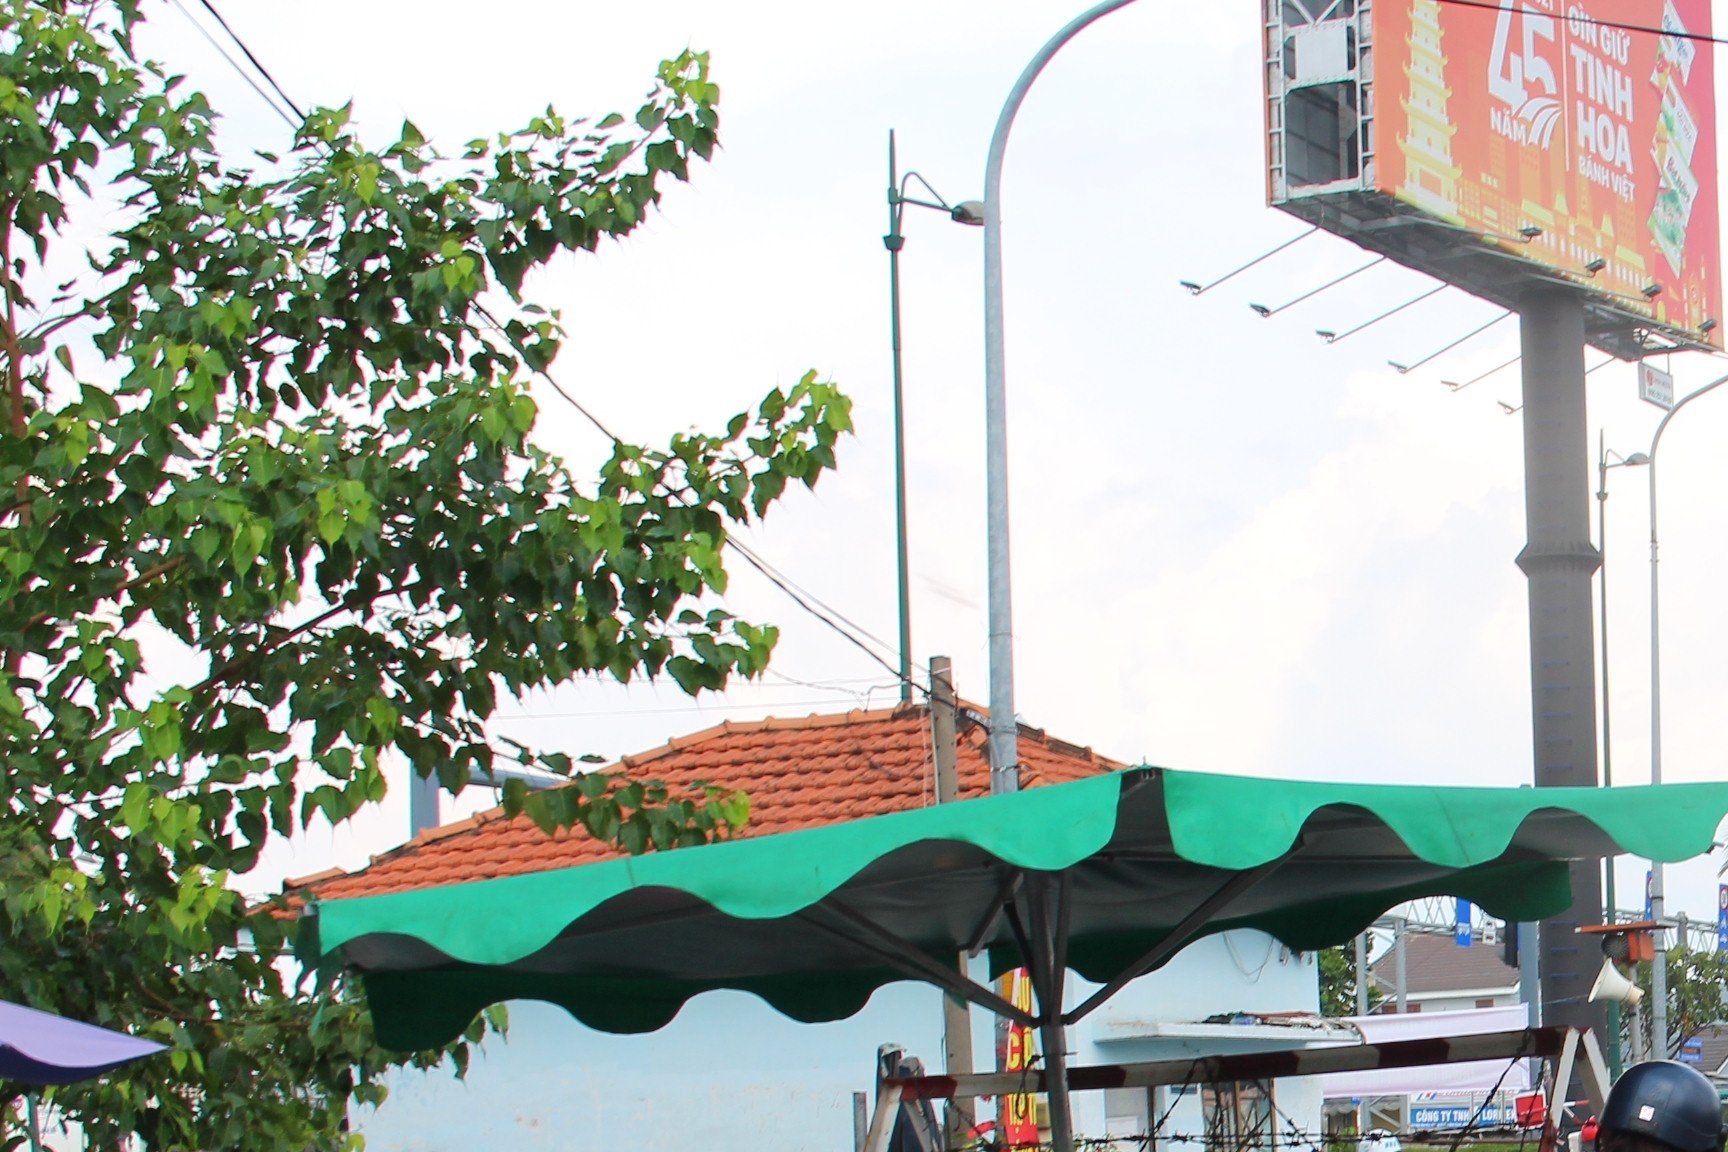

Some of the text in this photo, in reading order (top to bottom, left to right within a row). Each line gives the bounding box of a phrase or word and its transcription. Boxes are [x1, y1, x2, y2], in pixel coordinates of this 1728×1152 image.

[1570, 42, 1634, 123] TINH
[1490, 105, 1527, 147] NĂM
[1576, 100, 1634, 174] HOA
[1578, 154, 1610, 189] BÁNH
[1611, 171, 1636, 201] VIỆT
[1440, 1109, 1451, 1122] TY
[1453, 1107, 1476, 1121] TNH
